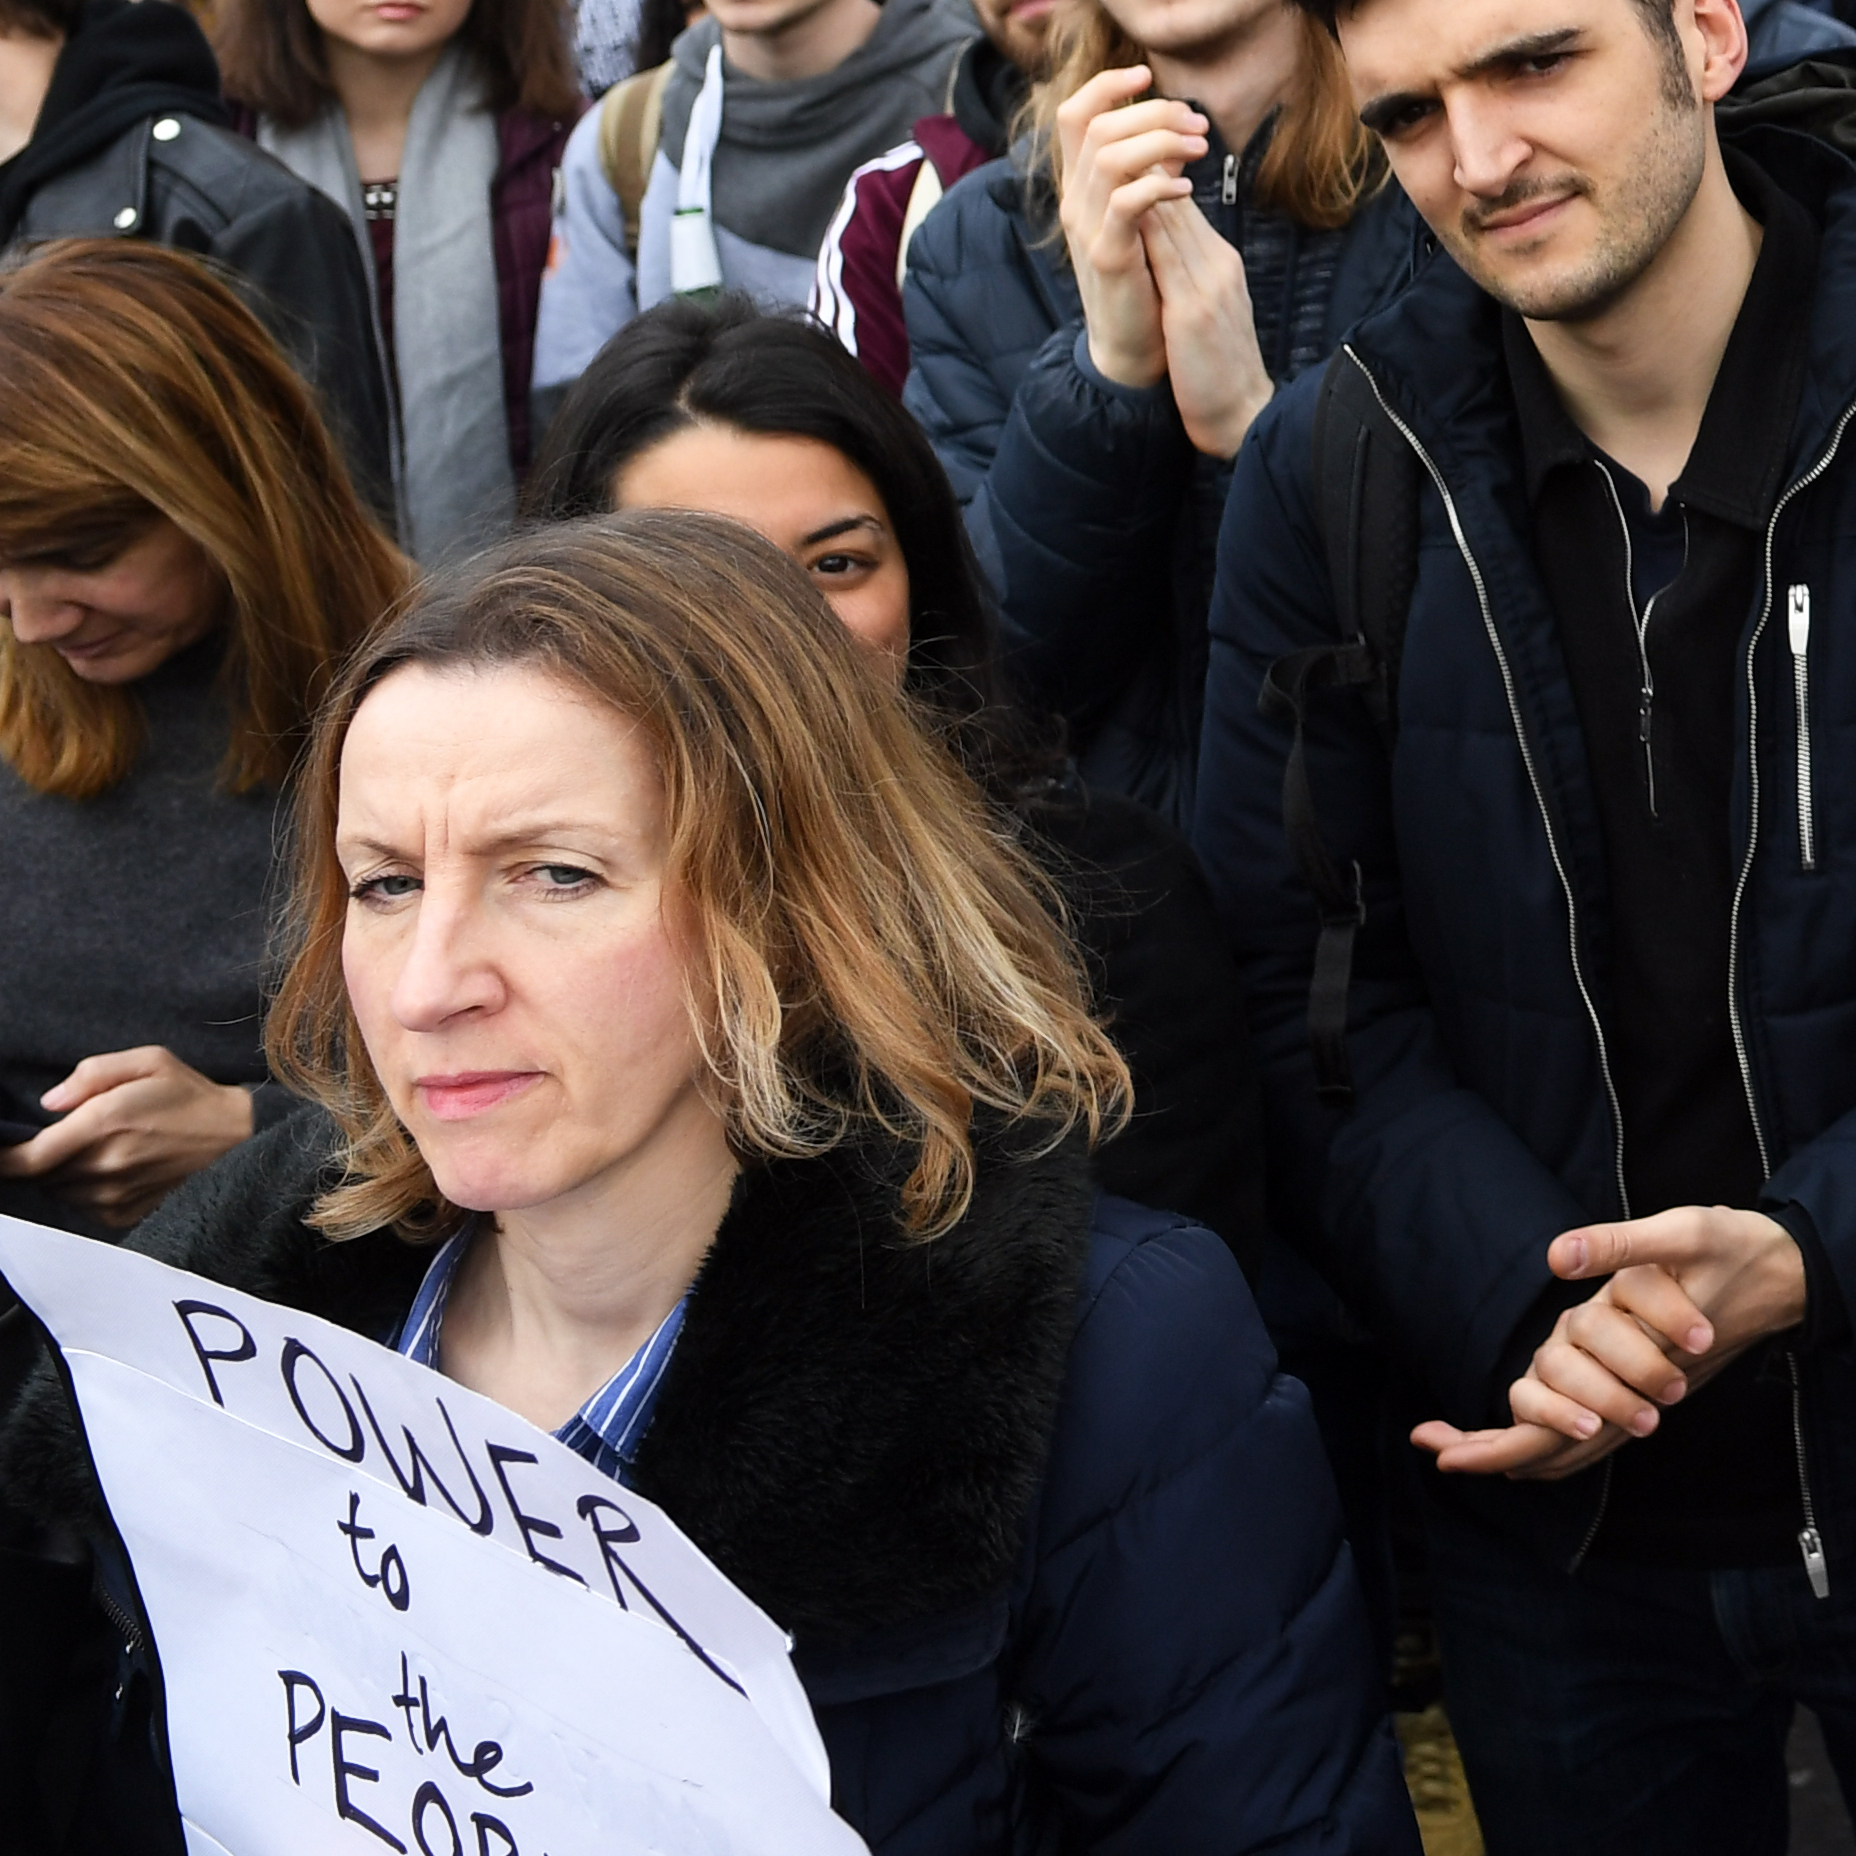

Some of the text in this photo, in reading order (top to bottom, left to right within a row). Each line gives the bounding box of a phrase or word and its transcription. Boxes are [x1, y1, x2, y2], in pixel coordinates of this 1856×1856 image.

[173, 1300, 750, 1699] POWER
[337, 1490, 409, 1611] to
[392, 1651, 533, 1798] the
